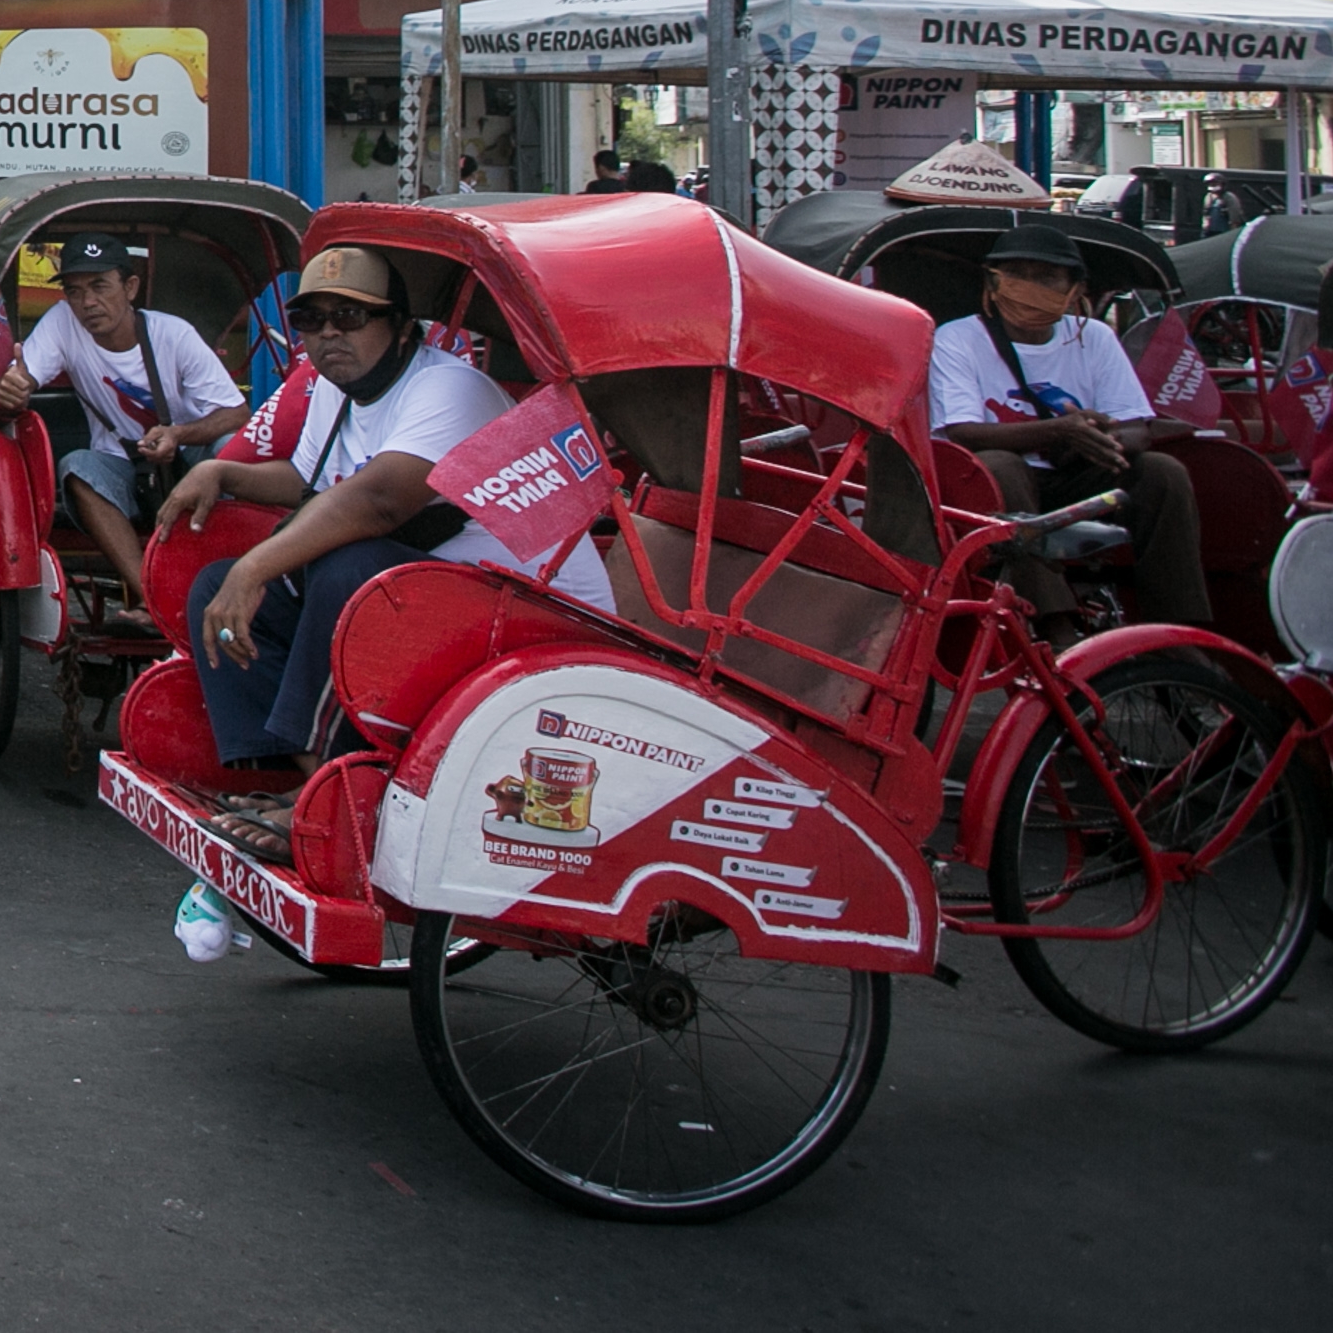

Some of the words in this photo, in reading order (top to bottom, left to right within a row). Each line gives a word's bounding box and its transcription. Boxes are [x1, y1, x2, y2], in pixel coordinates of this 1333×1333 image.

[462, 33, 521, 54] DINAS
[525, 21, 693, 52] PERDAGANGAN
[921, 18, 1026, 48] DINAS
[1038, 24, 1307, 60] PERDAGANGAN
[866, 77, 963, 93] NIPPON
[873, 94, 946, 109] PAINT
[928, 162, 1009, 178] LAWANG
[909, 174, 1023, 194] DJOENDJING
[564, 721, 643, 756] NIPPON
[645, 745, 705, 773] PAINT
[548, 764, 587, 775] NIPPON
[552, 773, 585, 783] PAINT
[127, 780, 160, 830] ayo
[485, 840, 509, 855] BEE
[511, 844, 557, 861] BRAND
[560, 851, 592, 866] 1000
